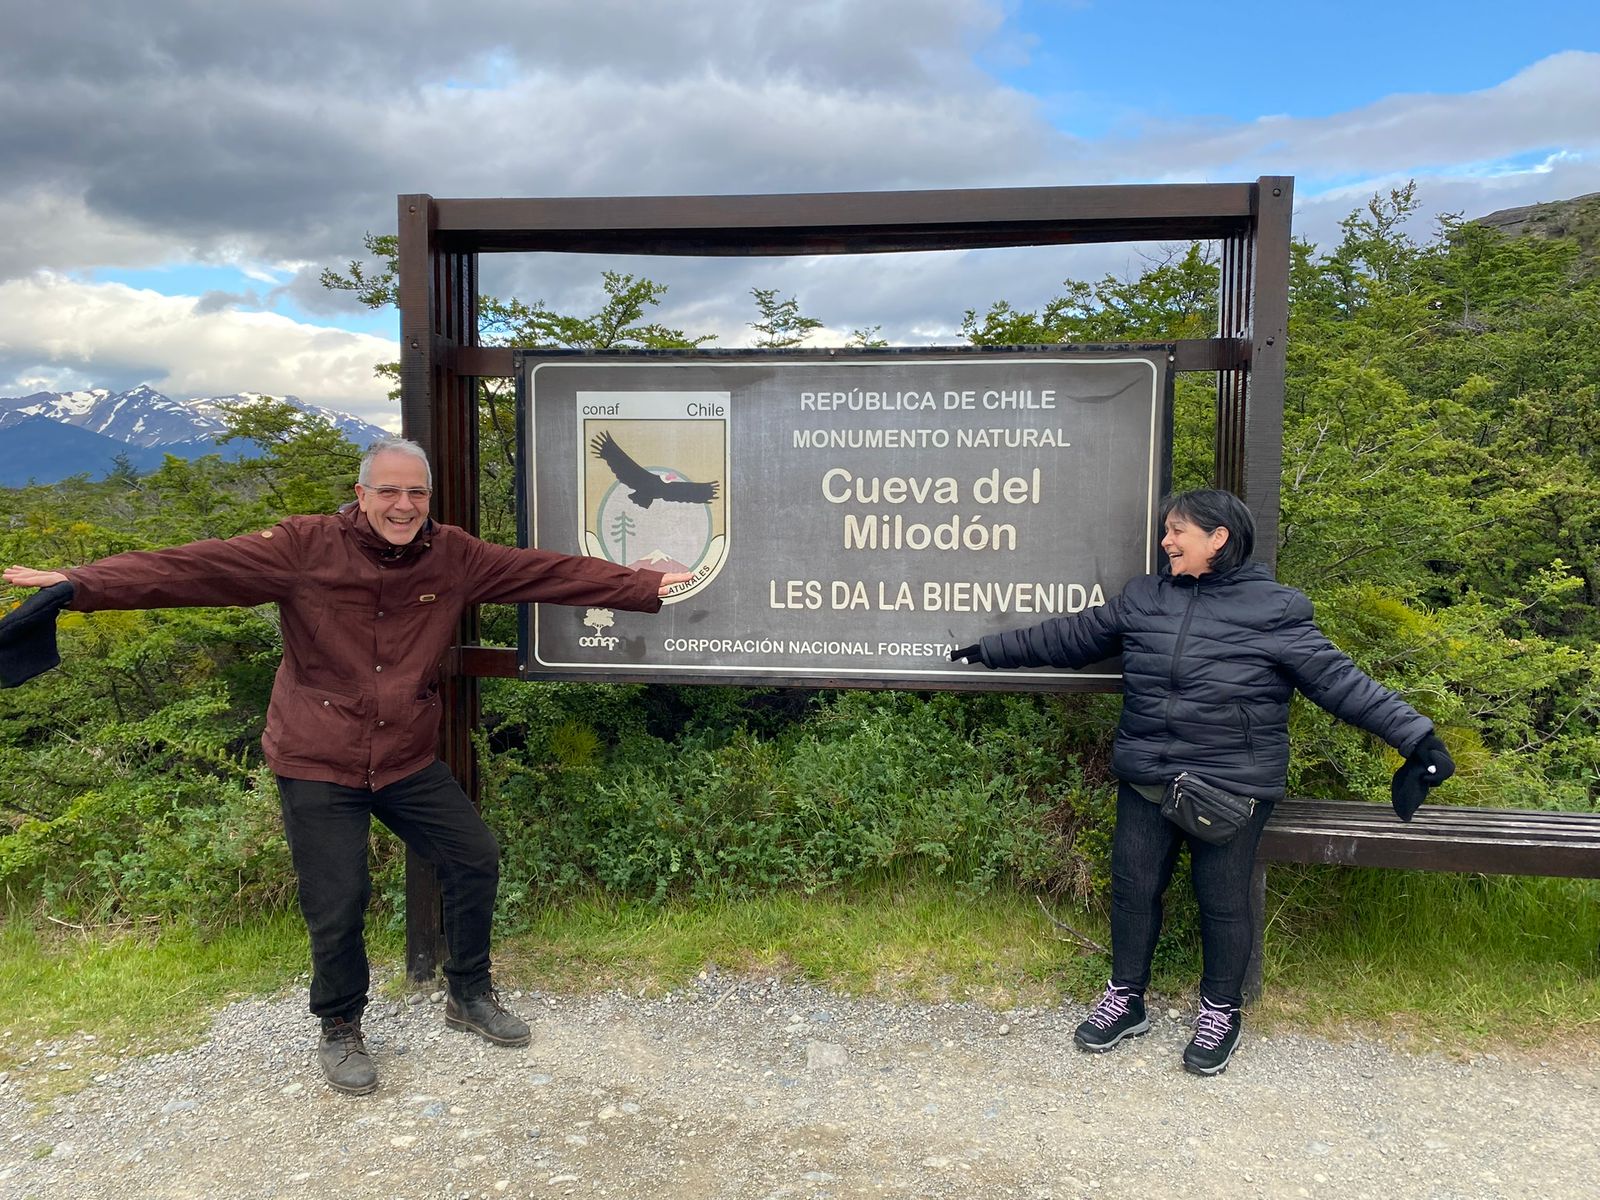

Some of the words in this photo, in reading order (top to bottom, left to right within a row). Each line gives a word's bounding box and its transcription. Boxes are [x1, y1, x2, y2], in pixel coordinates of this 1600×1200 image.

[582, 403, 620, 416] conaf
[687, 403, 725, 417] Chile
[800, 388, 936, 410] REPÚBLICA
[943, 390, 976, 409] DE
[982, 390, 1056, 409] CHILE
[793, 429, 950, 448] MONUMENTO
[957, 429, 1071, 448] NATURAL
[822, 468, 959, 503] Cueva
[973, 468, 1041, 503] del
[844, 515, 1017, 550] Milodón
[668, 565, 710, 594] ATURALES
[770, 580, 823, 609] LES
[831, 581, 870, 610] DA
[878, 581, 915, 611] LA
[923, 583, 1105, 613] BIENVENIDA
[579, 637, 620, 651] conaf
[664, 637, 784, 654] CORPORACIÓN
[788, 641, 874, 655] NACIONAL
